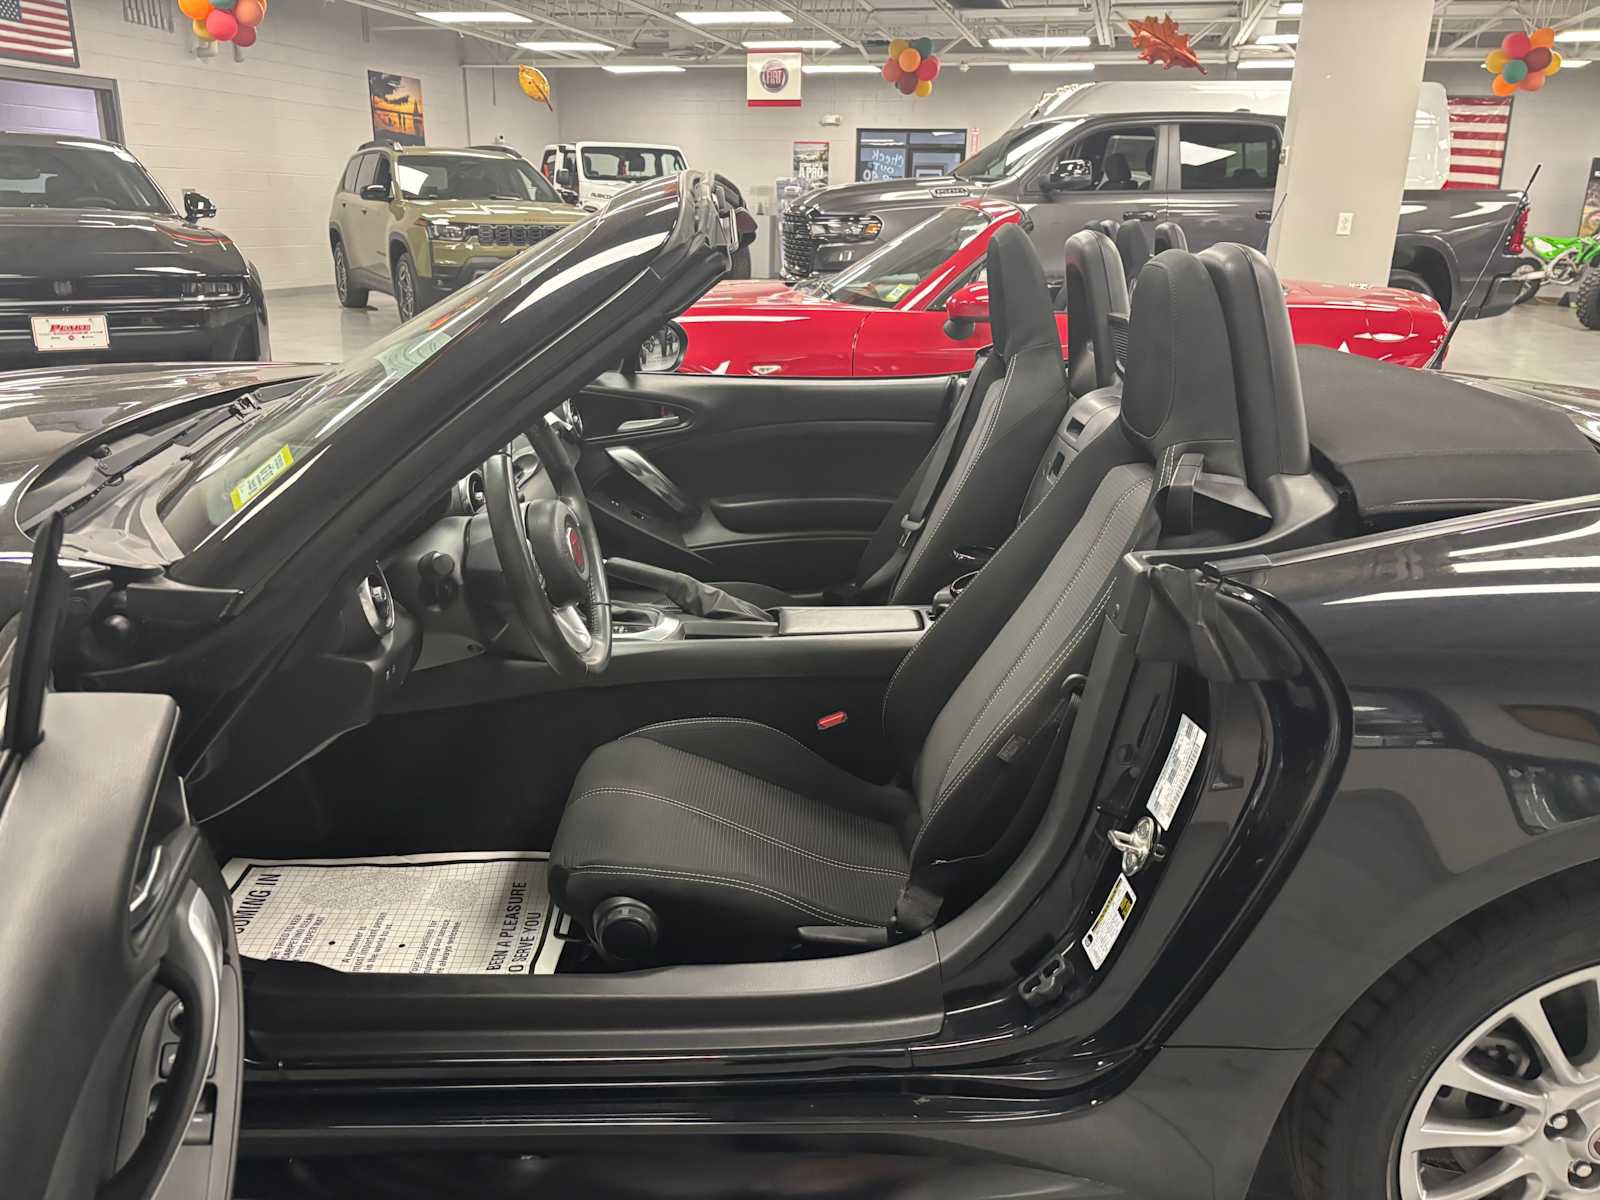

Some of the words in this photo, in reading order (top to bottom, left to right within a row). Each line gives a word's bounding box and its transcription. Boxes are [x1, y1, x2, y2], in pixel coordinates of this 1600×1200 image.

[766, 69, 784, 86] FIAT
[255, 873, 281, 886] IN
[500, 881, 527, 938] PLEASURE
[523, 912, 541, 933] YOU
[496, 938, 513, 949] A
[511, 936, 535, 962] SERVE
[486, 950, 508, 971] BEEN
[508, 965, 524, 973] O
